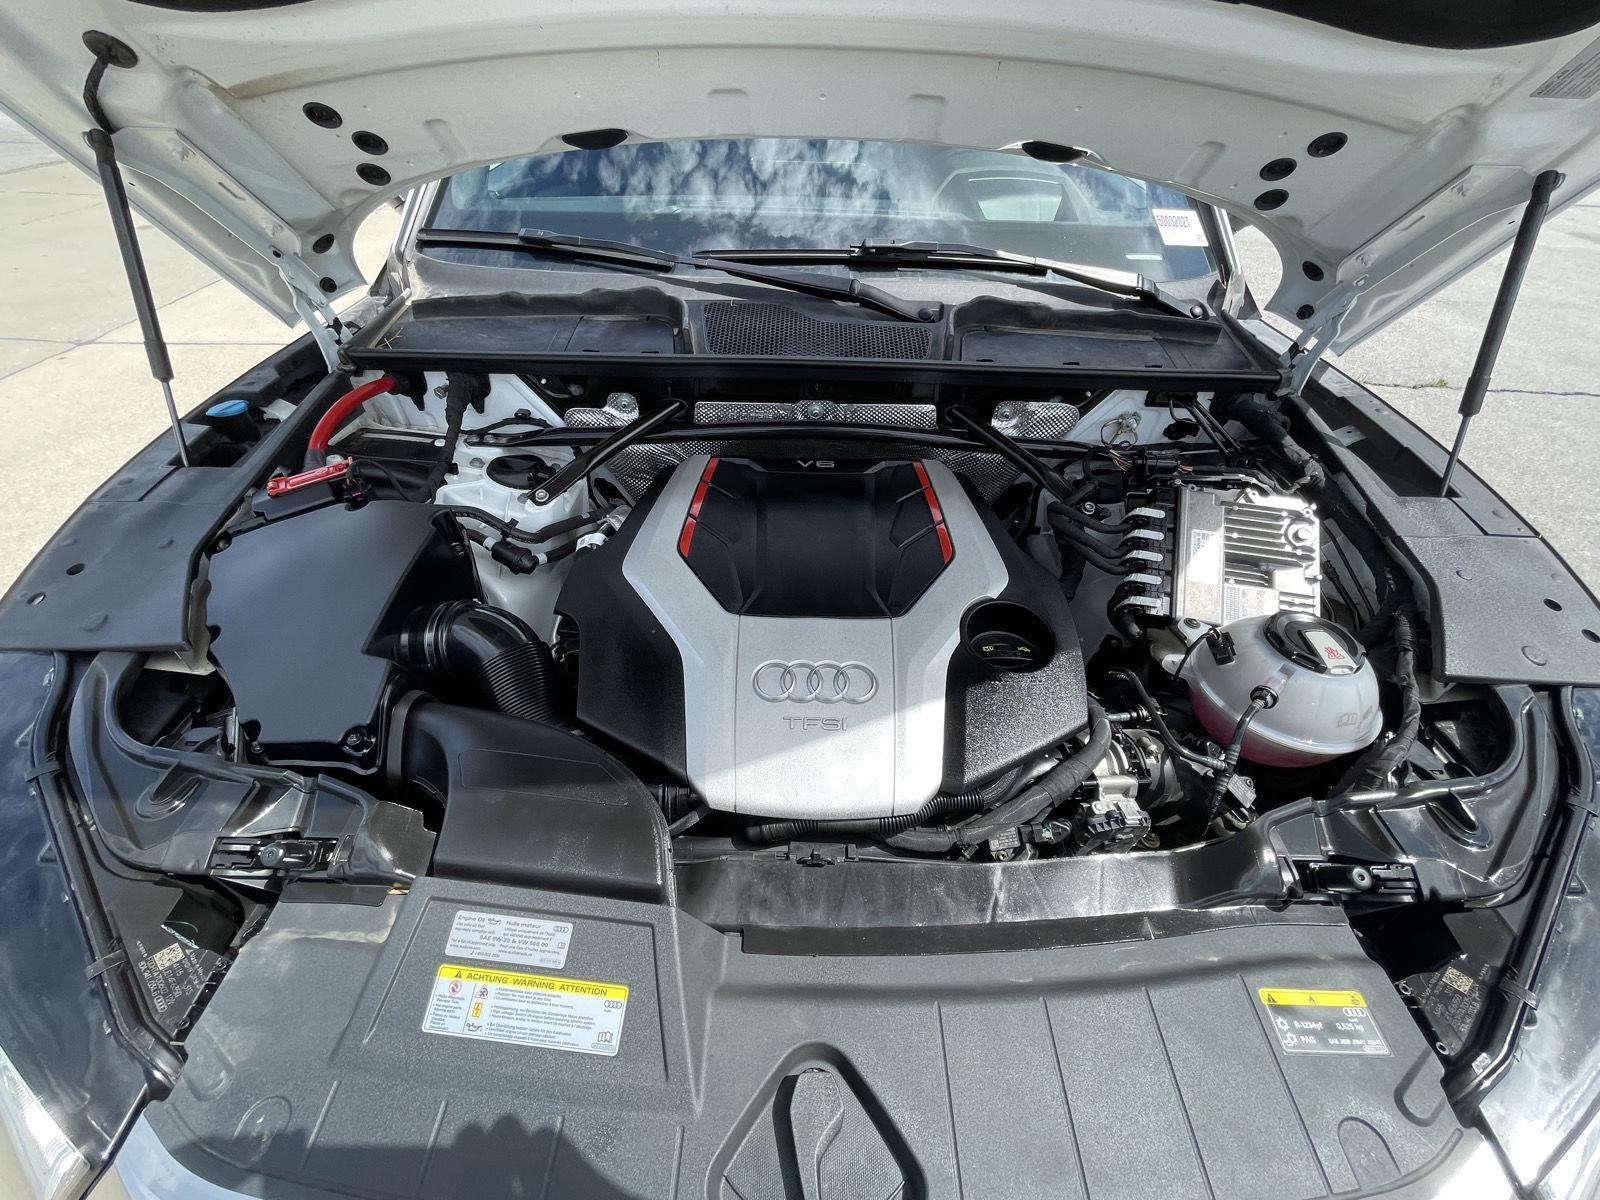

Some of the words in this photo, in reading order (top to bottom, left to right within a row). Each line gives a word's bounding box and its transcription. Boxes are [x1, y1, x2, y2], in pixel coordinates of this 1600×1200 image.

[797, 459, 835, 468] V6
[783, 716, 848, 732] TFSI
[465, 972, 508, 984] ACHTUNG
[512, 978, 555, 989] WARNING
[558, 983, 608, 996] ATTENTION
[1334, 1022, 1355, 1031] 0,525
[1353, 1023, 1365, 1031] kg
[1299, 1035, 1317, 1043] PAG
